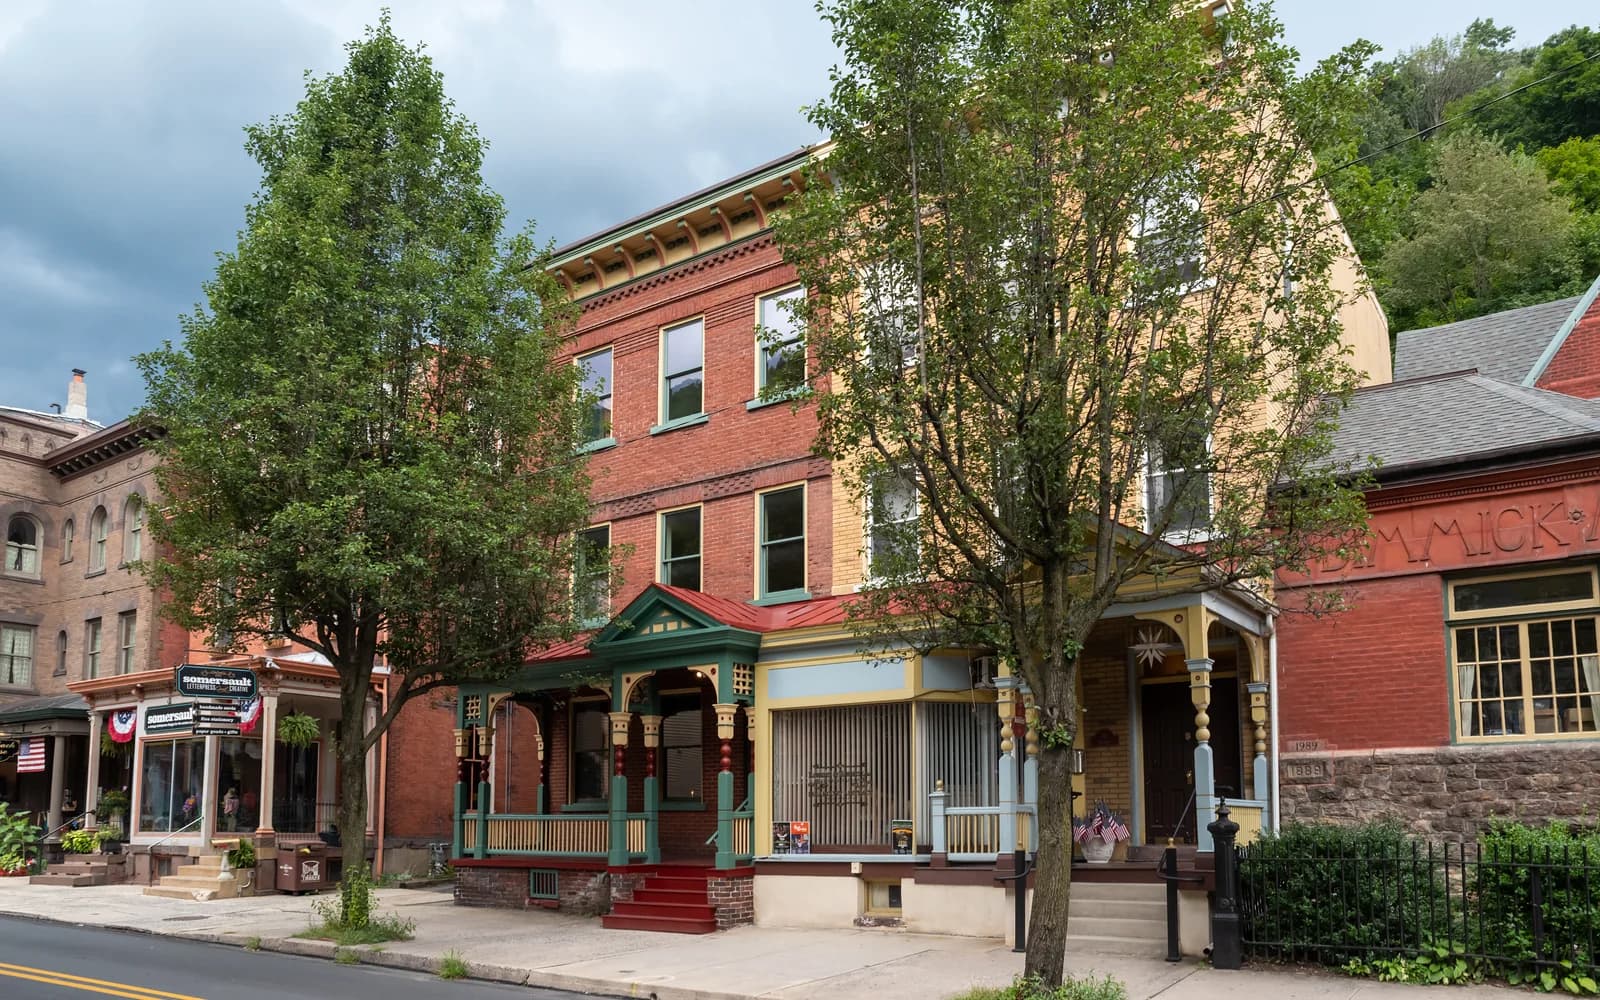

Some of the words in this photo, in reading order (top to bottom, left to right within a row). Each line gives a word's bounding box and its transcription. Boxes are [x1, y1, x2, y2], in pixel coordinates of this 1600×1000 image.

[1320, 502, 1570, 572] MMICK
[183, 675, 252, 687] somersault
[187, 683, 216, 691] LETTERPRESS
[229, 685, 248, 693] CREATIVE
[147, 707, 193, 724] somersaul
[1295, 741, 1318, 752] 1989
